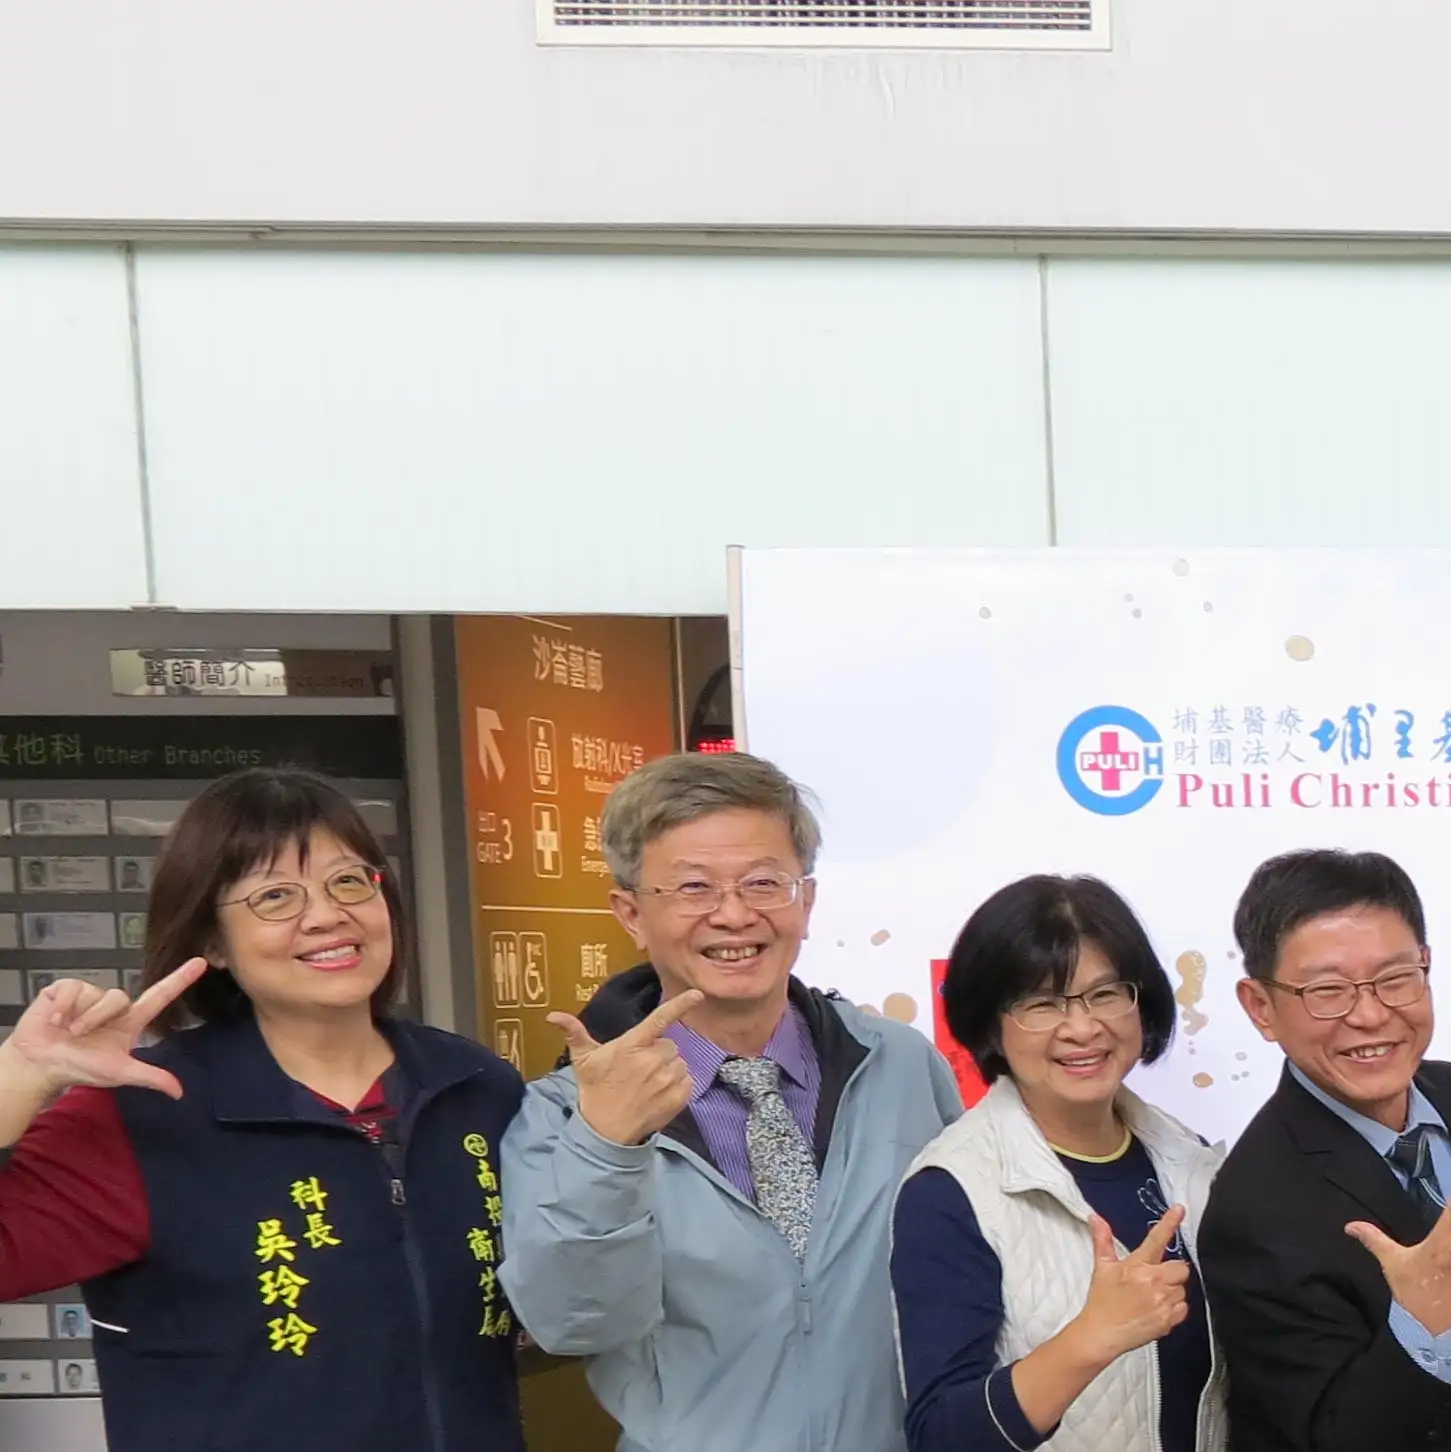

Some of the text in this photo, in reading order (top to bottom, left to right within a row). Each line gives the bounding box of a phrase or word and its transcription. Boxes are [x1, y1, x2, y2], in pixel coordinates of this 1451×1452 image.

[144, 660, 255, 687] 醫師簡介
[1171, 706, 1305, 734] 埔基醫療
[0, 733, 261, 766] 他科 Other Branches
[1081, 752, 1139, 771] PULI
[1176, 773, 1272, 809] Puli
[290, 1176, 341, 1249] 科長
[255, 1219, 318, 1357] 吳玲玲
